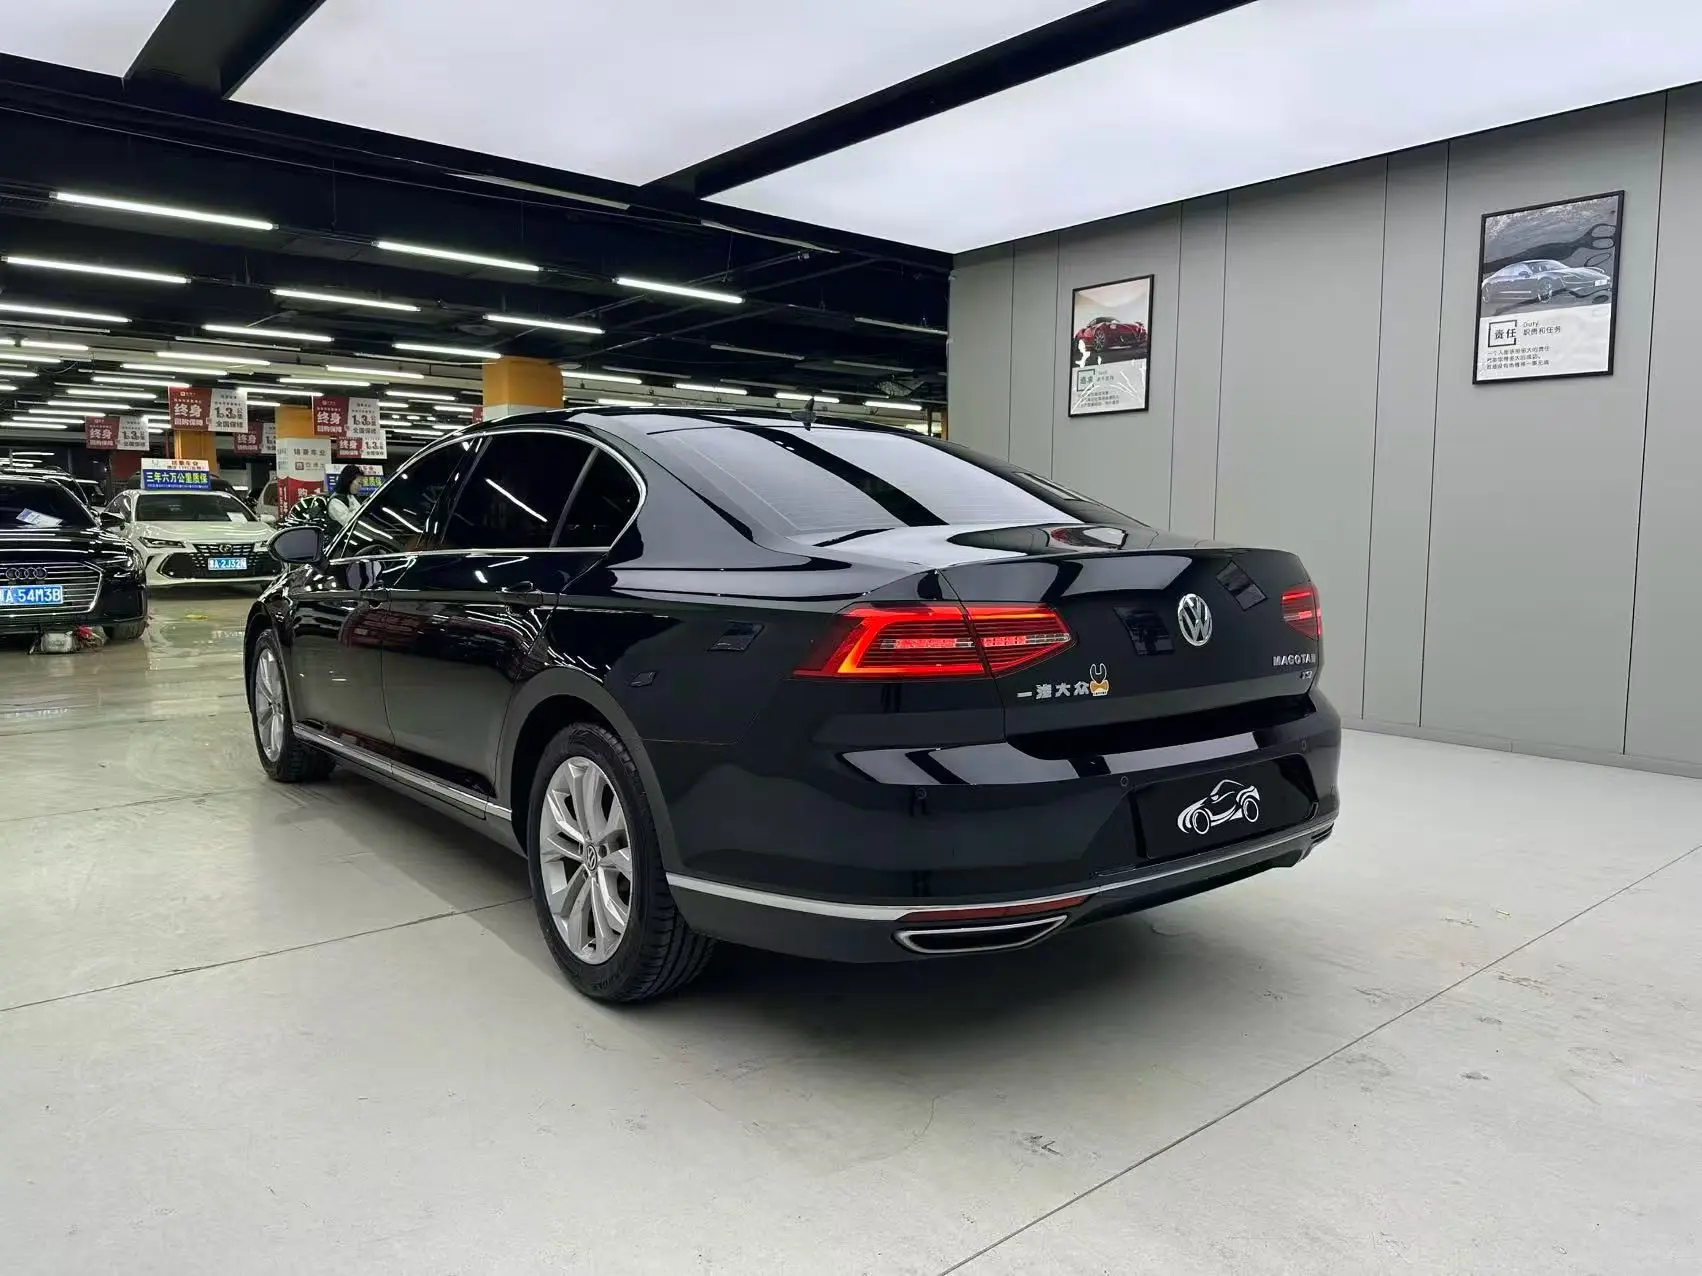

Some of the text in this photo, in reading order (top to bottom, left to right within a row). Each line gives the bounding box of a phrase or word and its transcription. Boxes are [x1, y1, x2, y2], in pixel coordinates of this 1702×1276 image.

[1494, 329, 1516, 339] 责任
[173, 404, 202, 417] 终身
[316, 411, 341, 424] 终身
[146, 472, 208, 483] 三年六万公里质保
[1272, 653, 1317, 666] MAGOTAN
